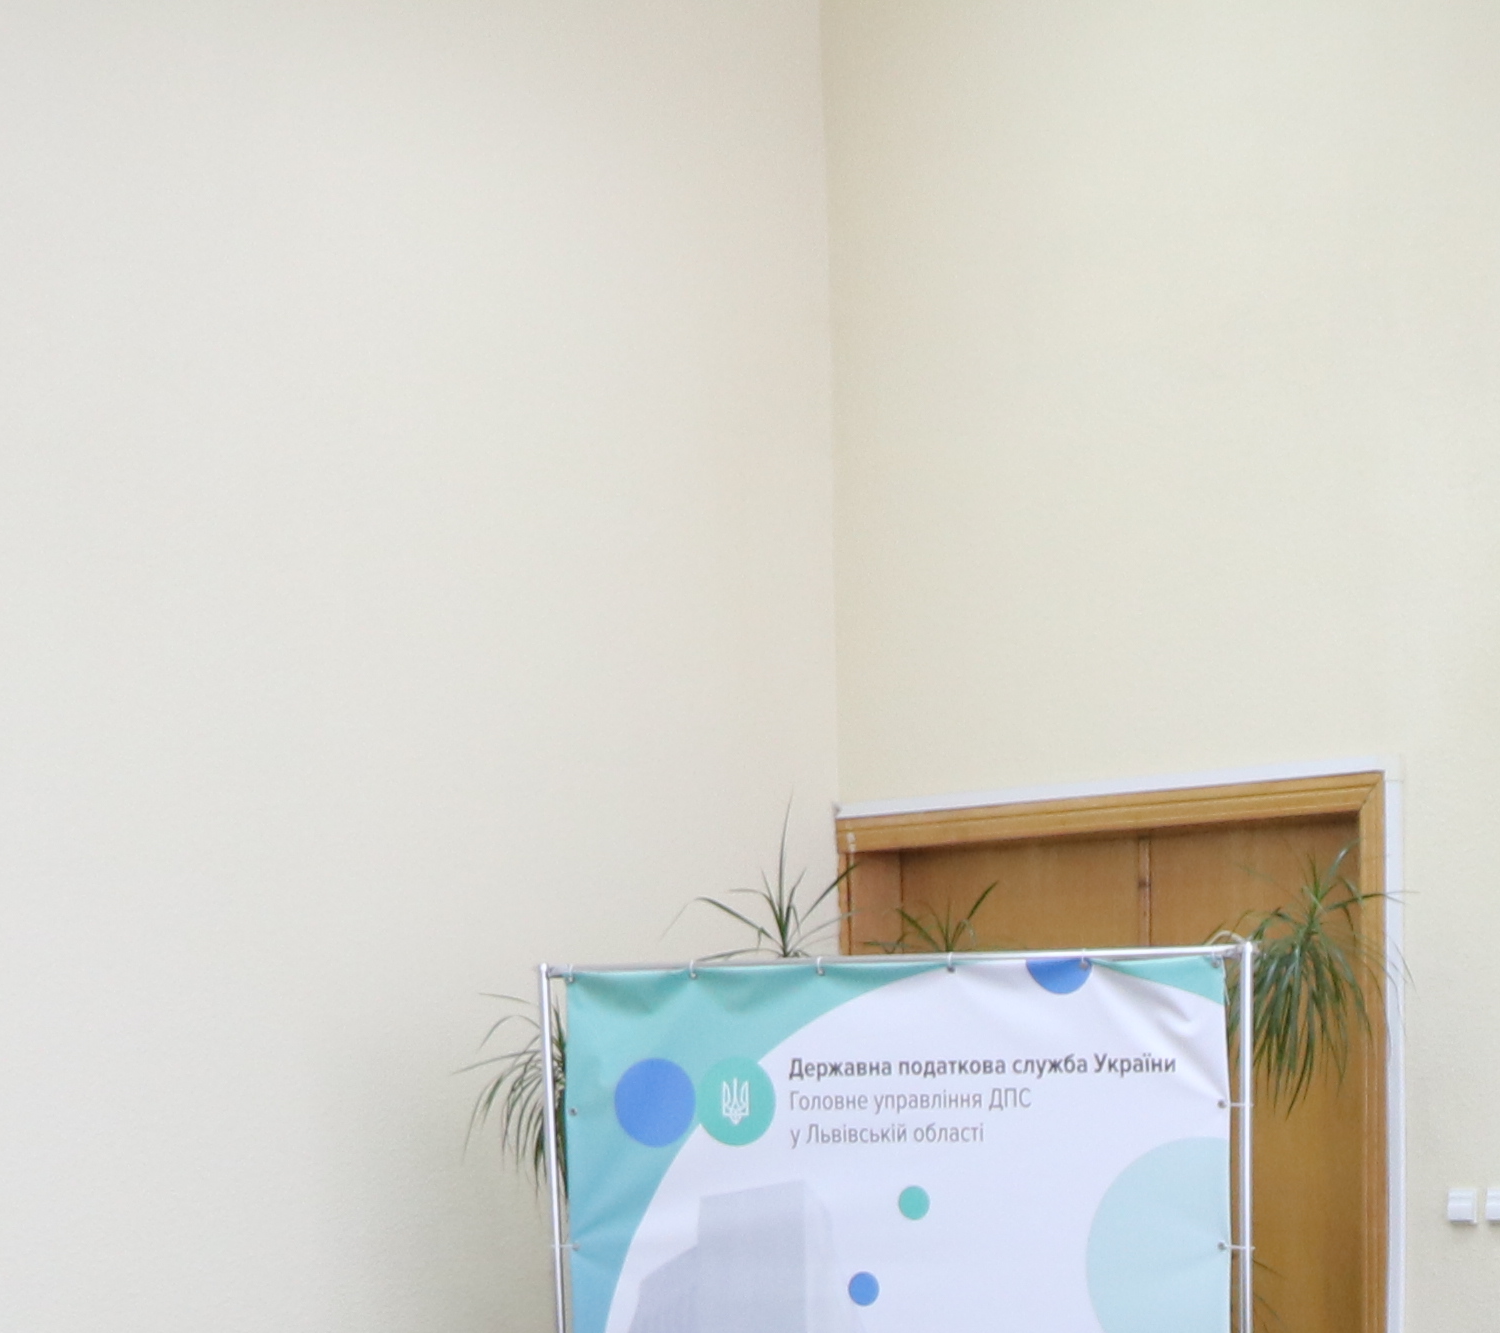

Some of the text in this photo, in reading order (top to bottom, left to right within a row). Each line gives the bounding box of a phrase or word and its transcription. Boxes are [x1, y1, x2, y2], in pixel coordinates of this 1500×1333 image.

[789, 1052, 1176, 1081] Державна податкова служба України
[790, 1087, 1032, 1114] Головне управління ДПС
[790, 1122, 985, 1148] у Львівській області
